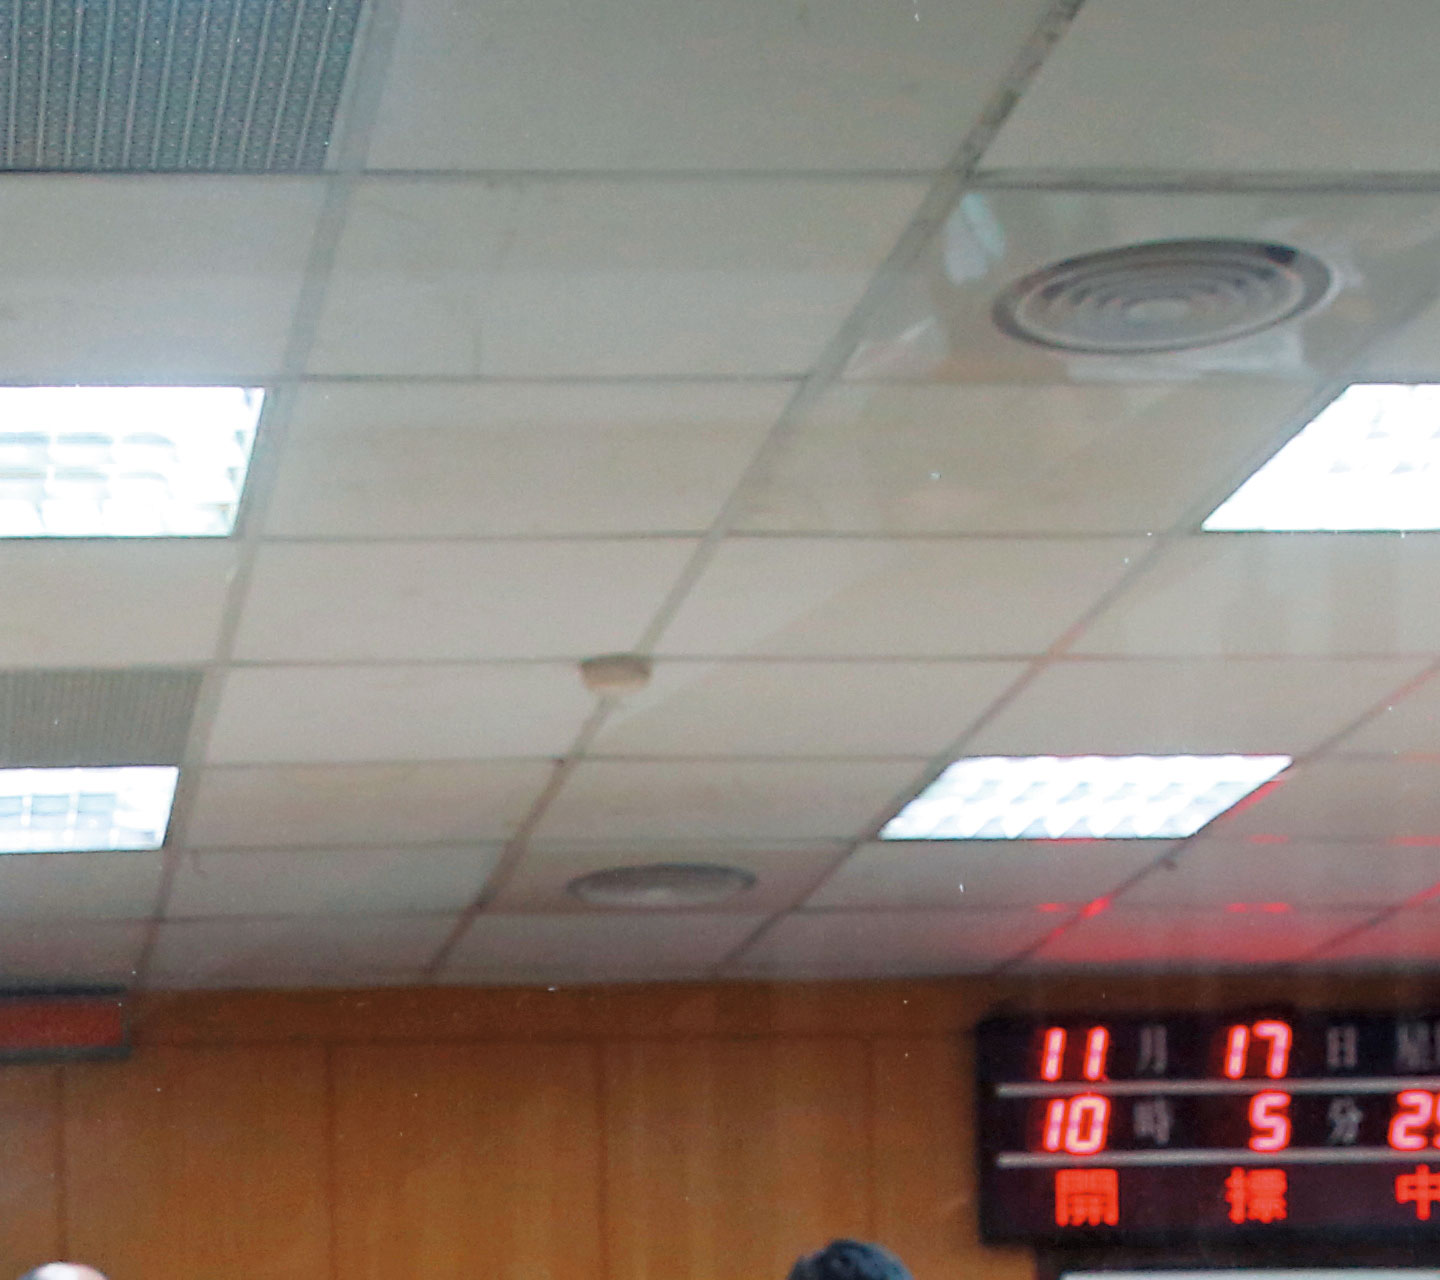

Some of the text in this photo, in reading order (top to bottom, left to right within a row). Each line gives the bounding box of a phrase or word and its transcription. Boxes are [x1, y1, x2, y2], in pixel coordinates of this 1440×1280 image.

[1041, 1026, 1109, 1081] 11
[1224, 1020, 1292, 1079] 17
[1042, 1092, 1111, 1156] 10
[1248, 1089, 1291, 1153] 5
